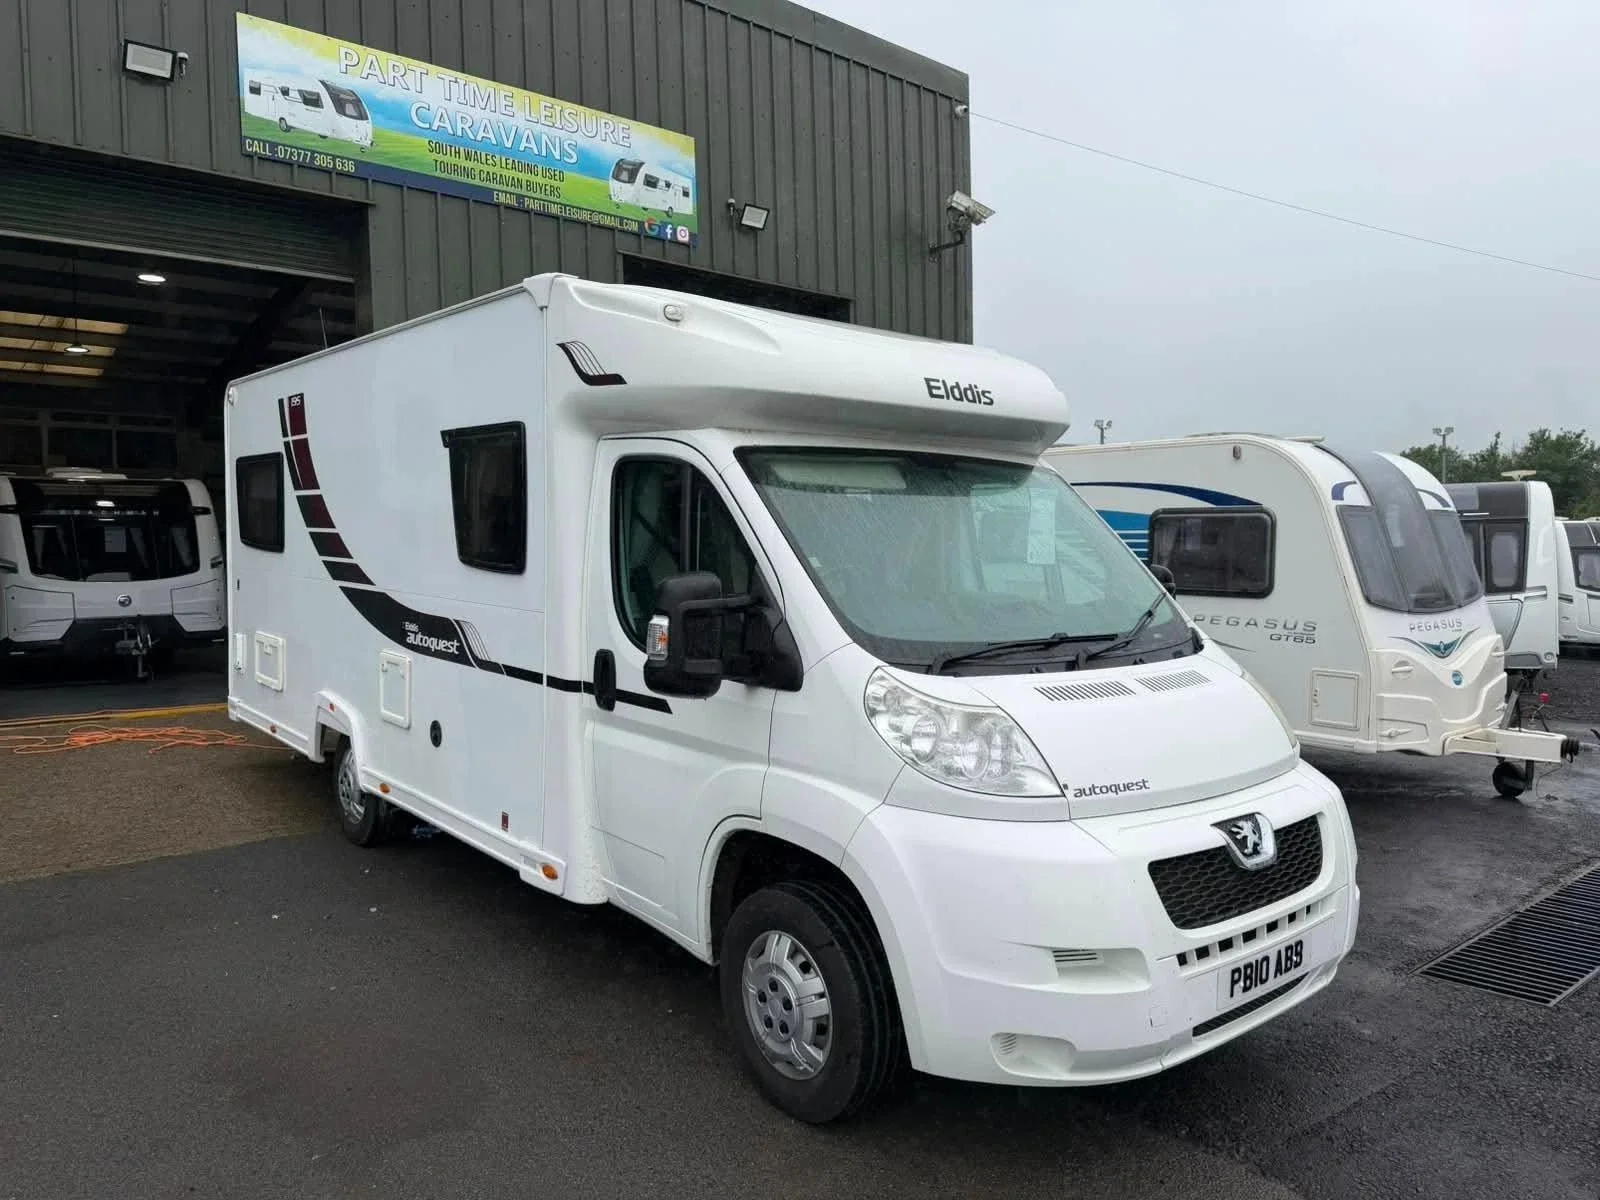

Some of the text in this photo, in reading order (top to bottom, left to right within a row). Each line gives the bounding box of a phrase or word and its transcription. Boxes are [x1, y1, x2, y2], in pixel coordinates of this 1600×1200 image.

[339, 46, 632, 148] PART TIME LEISURE
[409, 101, 579, 165] CARAVANS
[245, 139, 272, 156] CALL
[313, 153, 334, 168] 305
[335, 158, 356, 173] 636
[428, 139, 565, 183] SOUTH WALES LEADING USED
[433, 158, 561, 198] TOURING CARAVAN BUYERS
[493, 190, 518, 207] EMAIL
[524, 197, 639, 232] PARTTIMELEISURE@GMAIL.COM
[923, 377, 994, 406] Elddis
[1193, 614, 1318, 633] PEGASUS
[1269, 633, 1317, 645] GT65
[1409, 618, 1463, 632] PEGASUS
[406, 631, 461, 655] autoquest
[1073, 779, 1151, 798] autoquest
[1230, 955, 1270, 998] PB10
